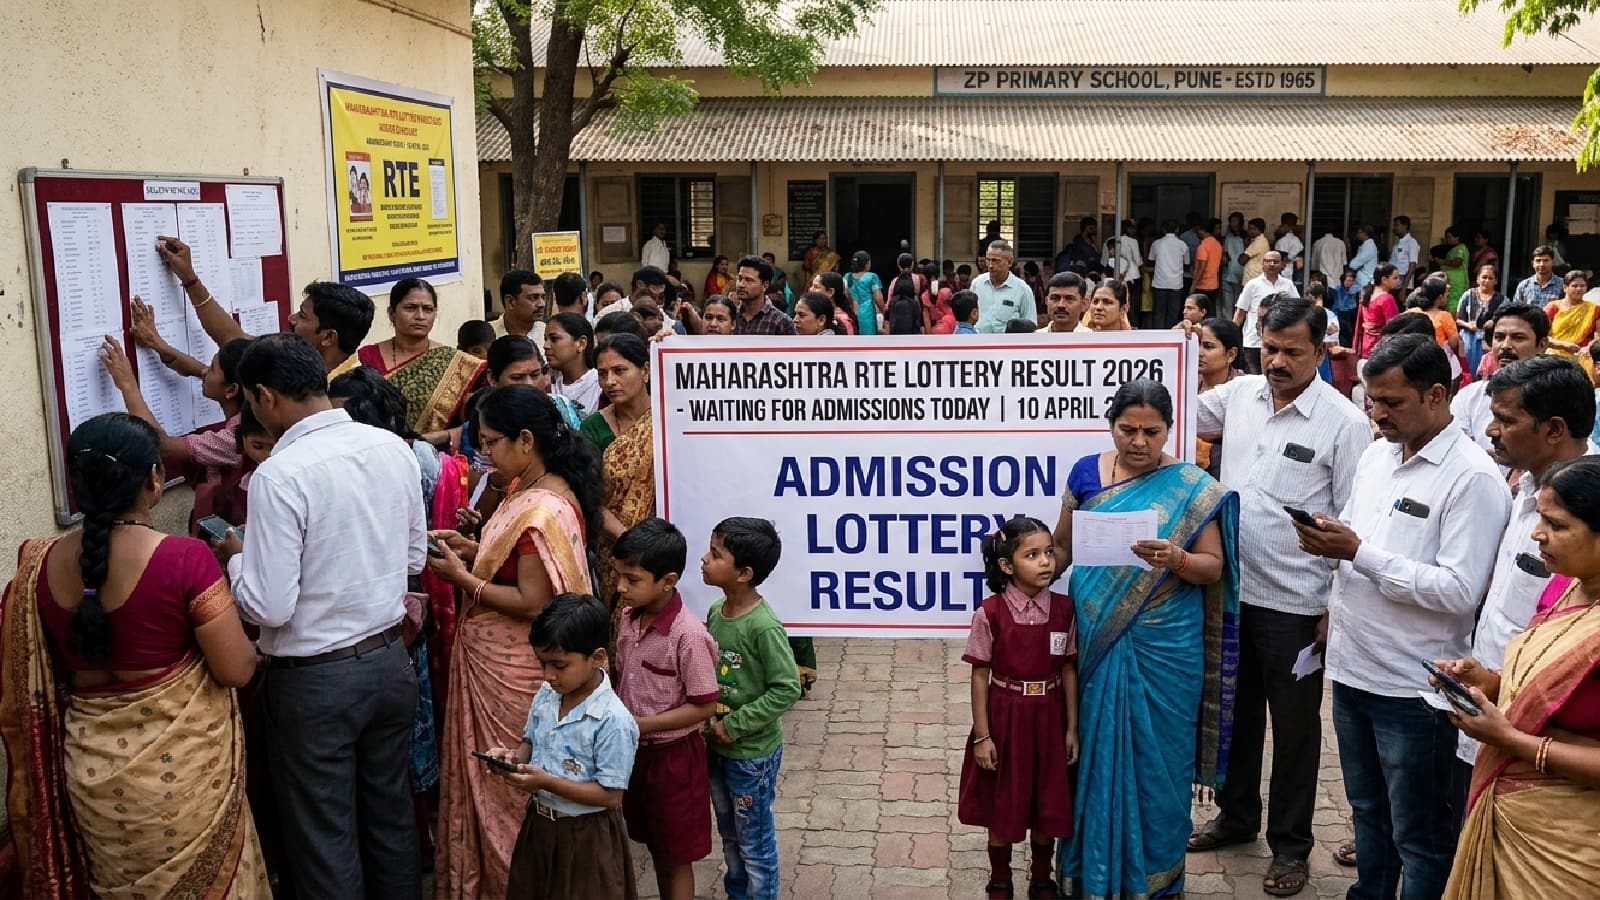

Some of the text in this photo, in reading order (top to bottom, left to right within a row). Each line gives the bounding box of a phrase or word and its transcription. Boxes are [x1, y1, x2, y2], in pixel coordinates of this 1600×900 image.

[964, 71, 990, 89] ZP
[996, 71, 1084, 89] PRIMARY
[1090, 70, 1169, 90] SCHOOL,
[1174, 70, 1222, 89] PUNE
[1235, 71, 1275, 89] ESTD
[1280, 71, 1316, 89] 1965
[383, 160, 421, 198] RTE
[675, 358, 1164, 390] MAHARASHTRA RTE LOTTERY RESULT 2026
[688, 399, 766, 422] WAITING
[771, 399, 807, 422] FOR
[811, 398, 925, 421] ADMISSIONS
[930, 397, 991, 421] TODAY
[1017, 397, 1039, 420] 10
[1044, 396, 1099, 419] APRIL
[773, 455, 1057, 500] ADMISSION
[810, 569, 985, 613] RESULT
